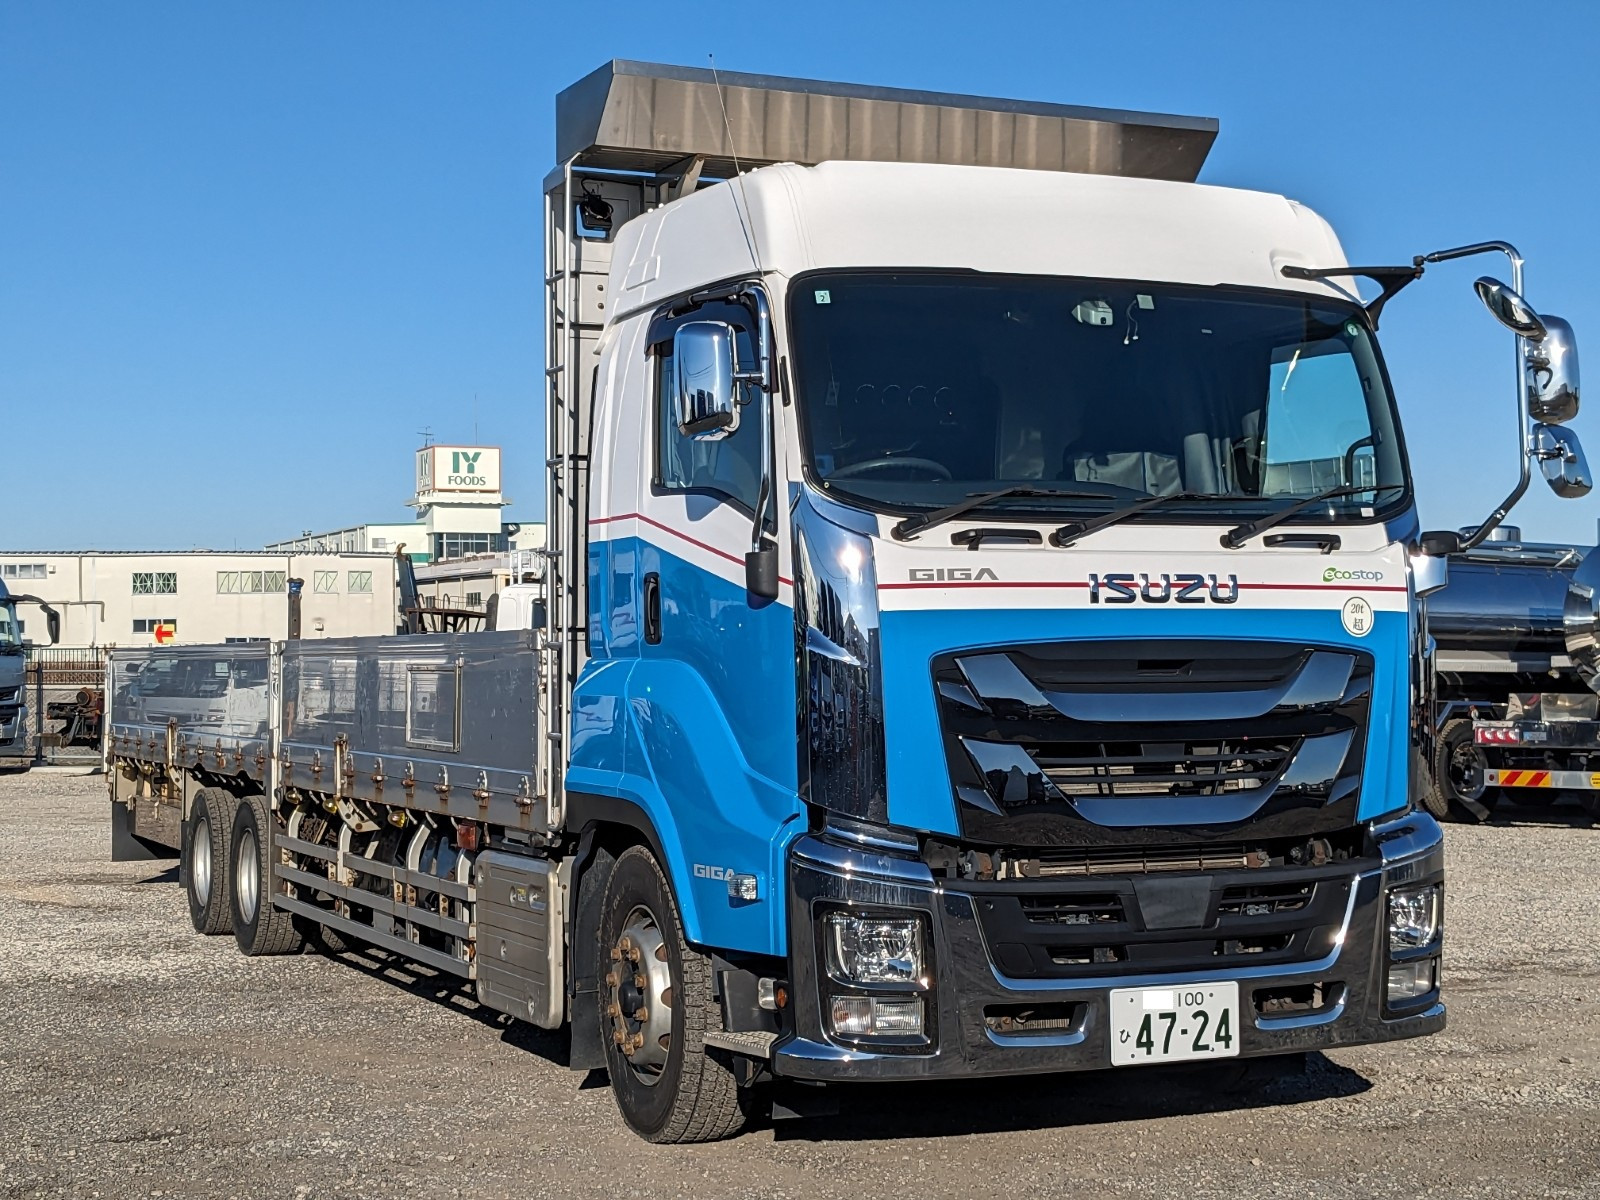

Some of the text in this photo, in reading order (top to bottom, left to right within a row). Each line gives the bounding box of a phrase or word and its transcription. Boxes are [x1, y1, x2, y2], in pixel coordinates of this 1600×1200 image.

[452, 451, 482, 474] IY
[448, 475, 486, 486] FOODS
[908, 567, 1000, 581] GIGA
[1323, 567, 1384, 582] ecostop
[1088, 573, 1239, 604] ISUZU
[1350, 603, 1364, 614] 20t
[693, 863, 735, 881] GIGA
[1178, 991, 1204, 1007] 100
[1119, 1029, 1131, 1044] ひ
[1135, 1008, 1232, 1055] 47-24
